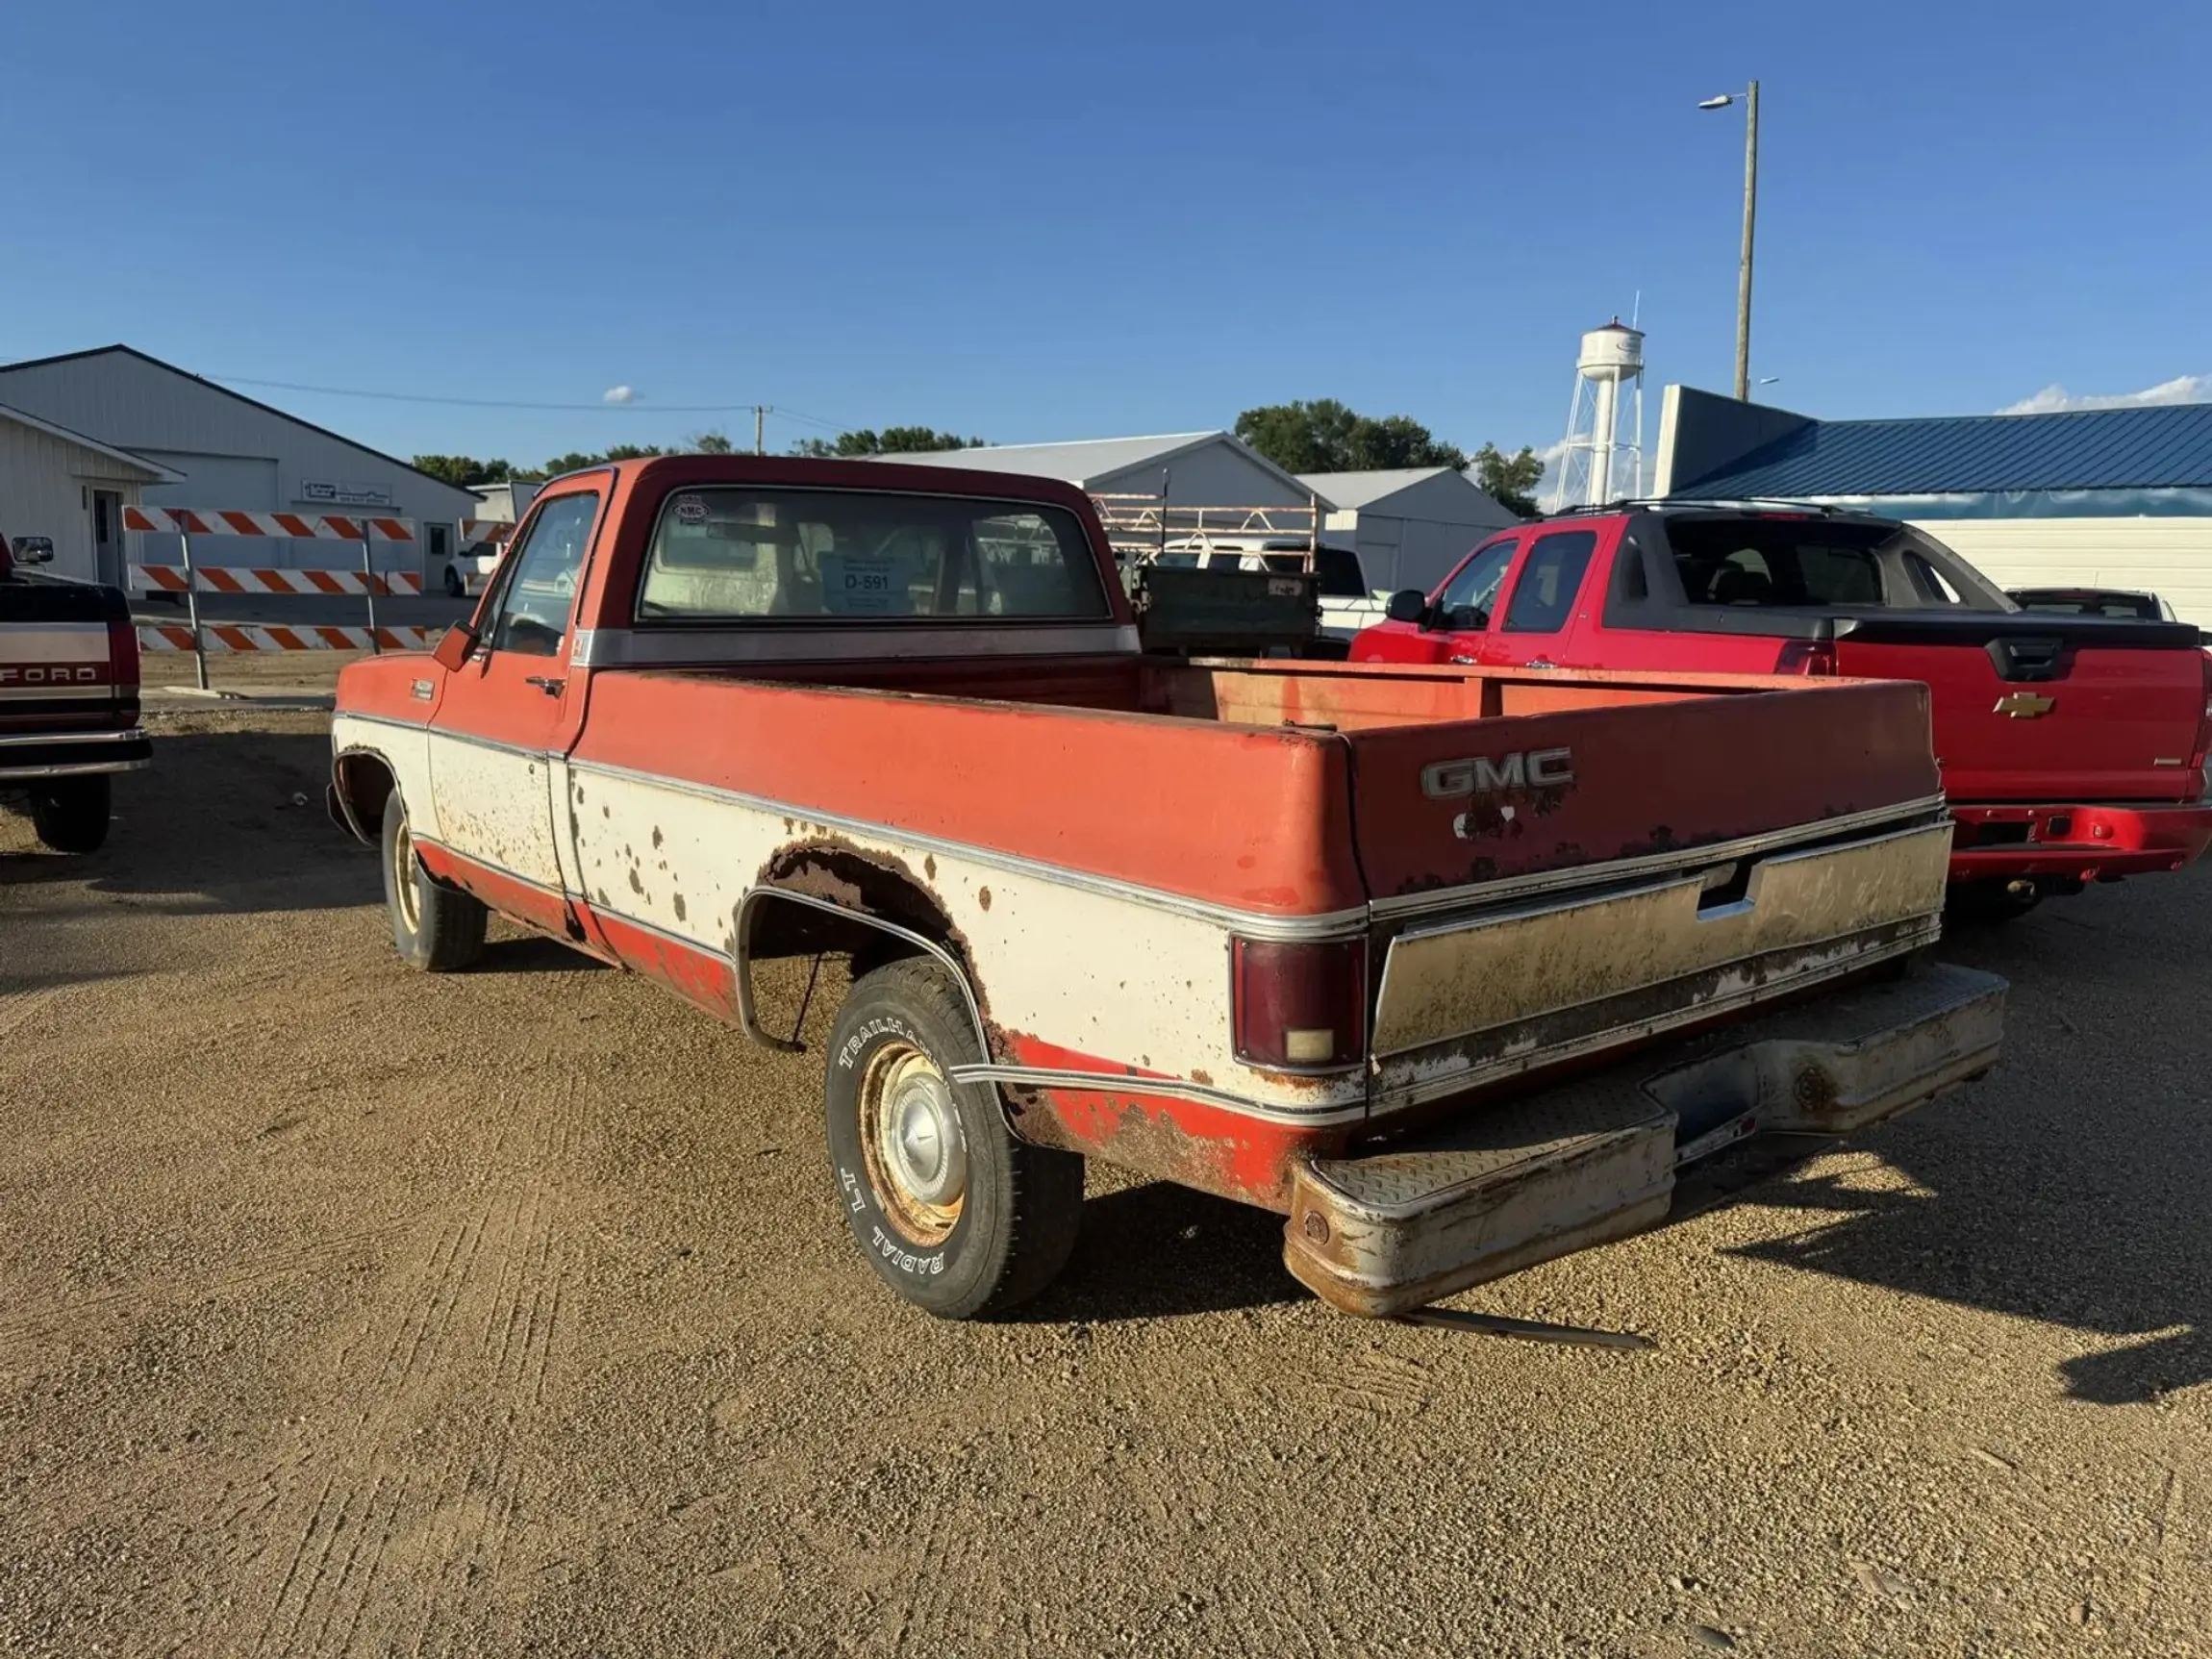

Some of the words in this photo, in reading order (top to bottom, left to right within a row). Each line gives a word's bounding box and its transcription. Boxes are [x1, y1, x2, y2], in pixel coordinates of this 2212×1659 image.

[844, 574, 889, 590] D-591
[0, 666, 96, 681] FORD
[1421, 746, 1574, 799] GMC
[841, 1168, 866, 1214] LT
[872, 1226, 945, 1275] RADIAL
